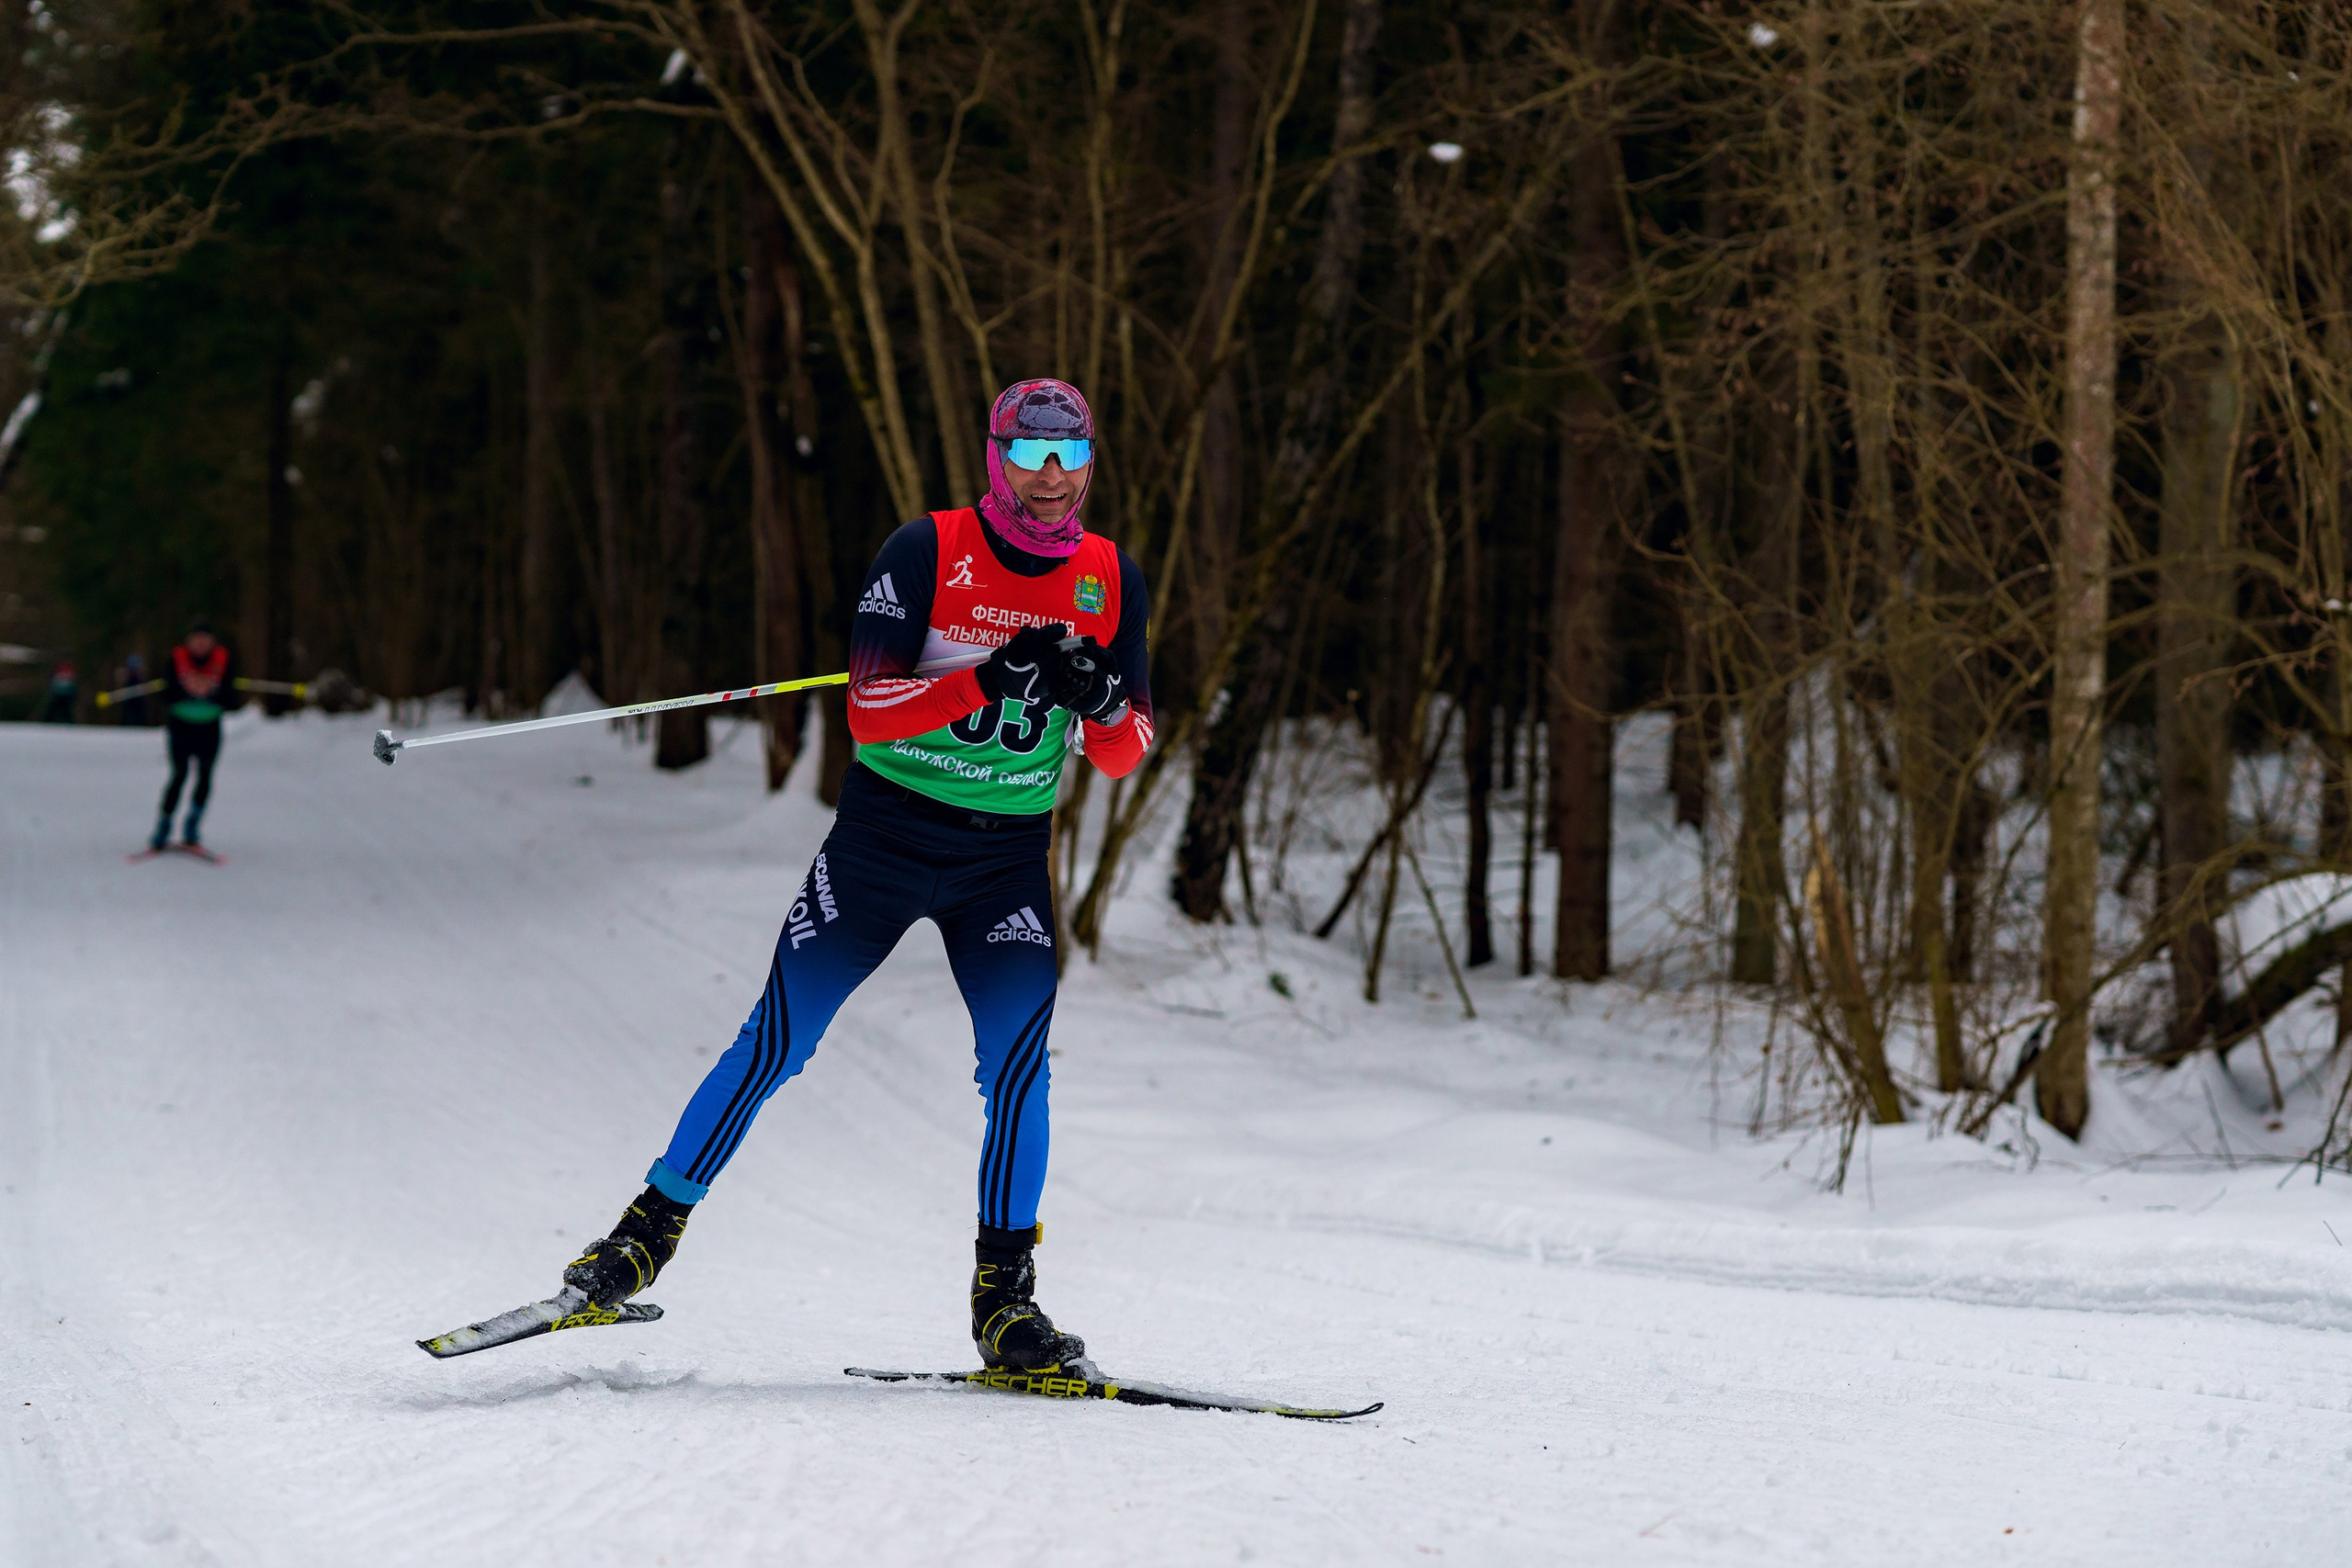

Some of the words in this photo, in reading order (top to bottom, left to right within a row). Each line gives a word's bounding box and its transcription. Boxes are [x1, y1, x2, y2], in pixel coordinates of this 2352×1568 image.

[858, 597, 906, 619] adidas
[889, 739, 992, 782] КАЛУЖСКОЙ
[815, 852, 840, 923] SCANIA
[987, 928, 1051, 947] adidas
